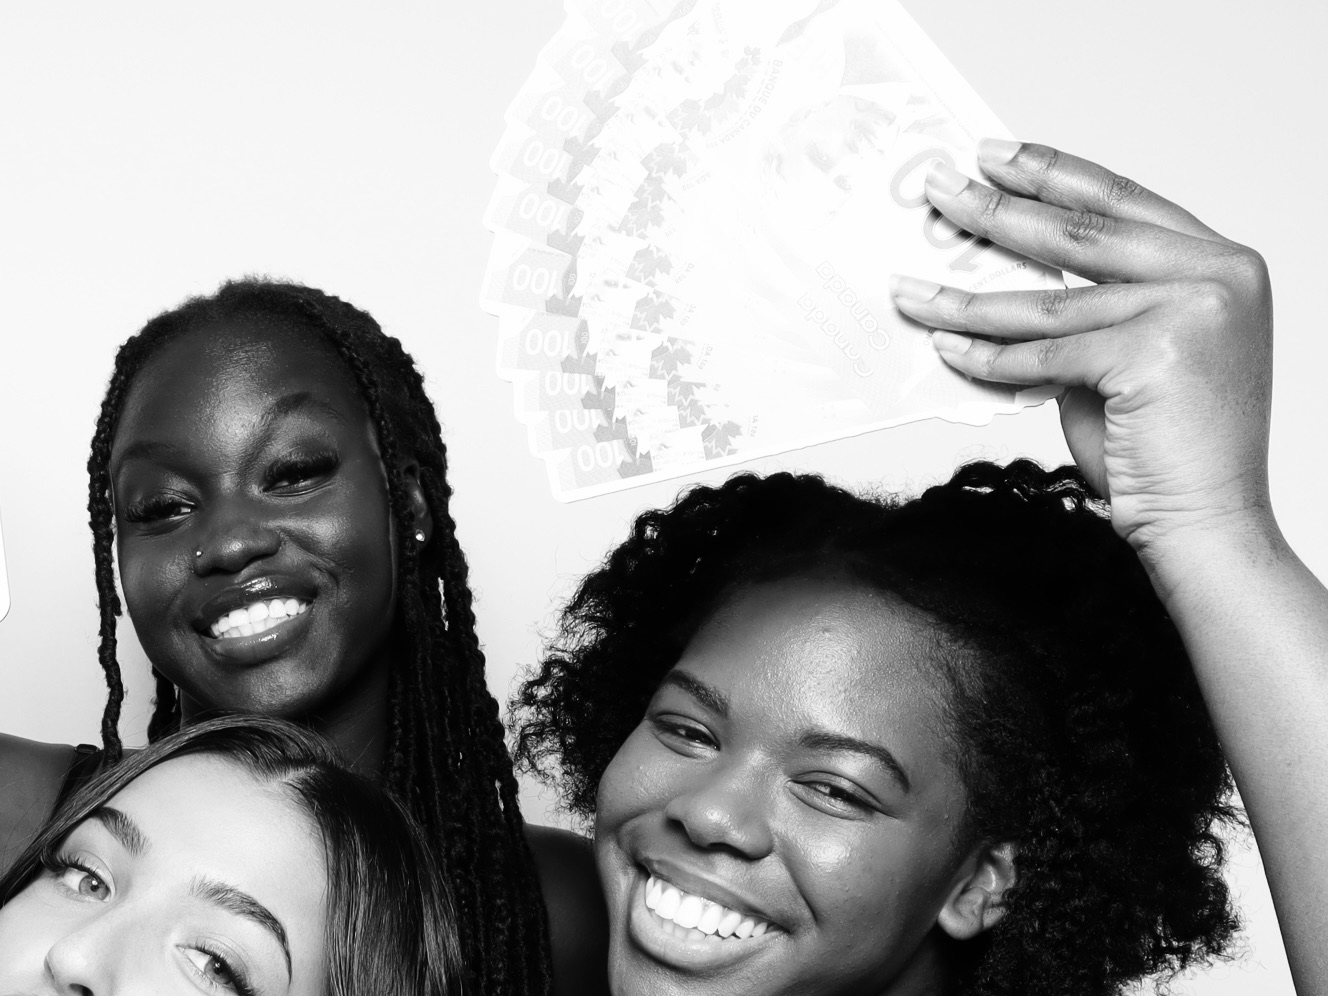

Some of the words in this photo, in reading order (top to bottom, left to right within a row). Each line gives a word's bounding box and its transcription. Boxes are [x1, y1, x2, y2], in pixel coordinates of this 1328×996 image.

[542, 96, 587, 136] 100
[524, 141, 567, 177] 100
[519, 193, 564, 229] 100
[513, 264, 558, 297] 100
[989, 262, 1027, 280] DOLLARS
[815, 259, 891, 351] Canada
[525, 329, 570, 359] 100
[545, 371, 590, 396] 100
[576, 440, 624, 472] 100
